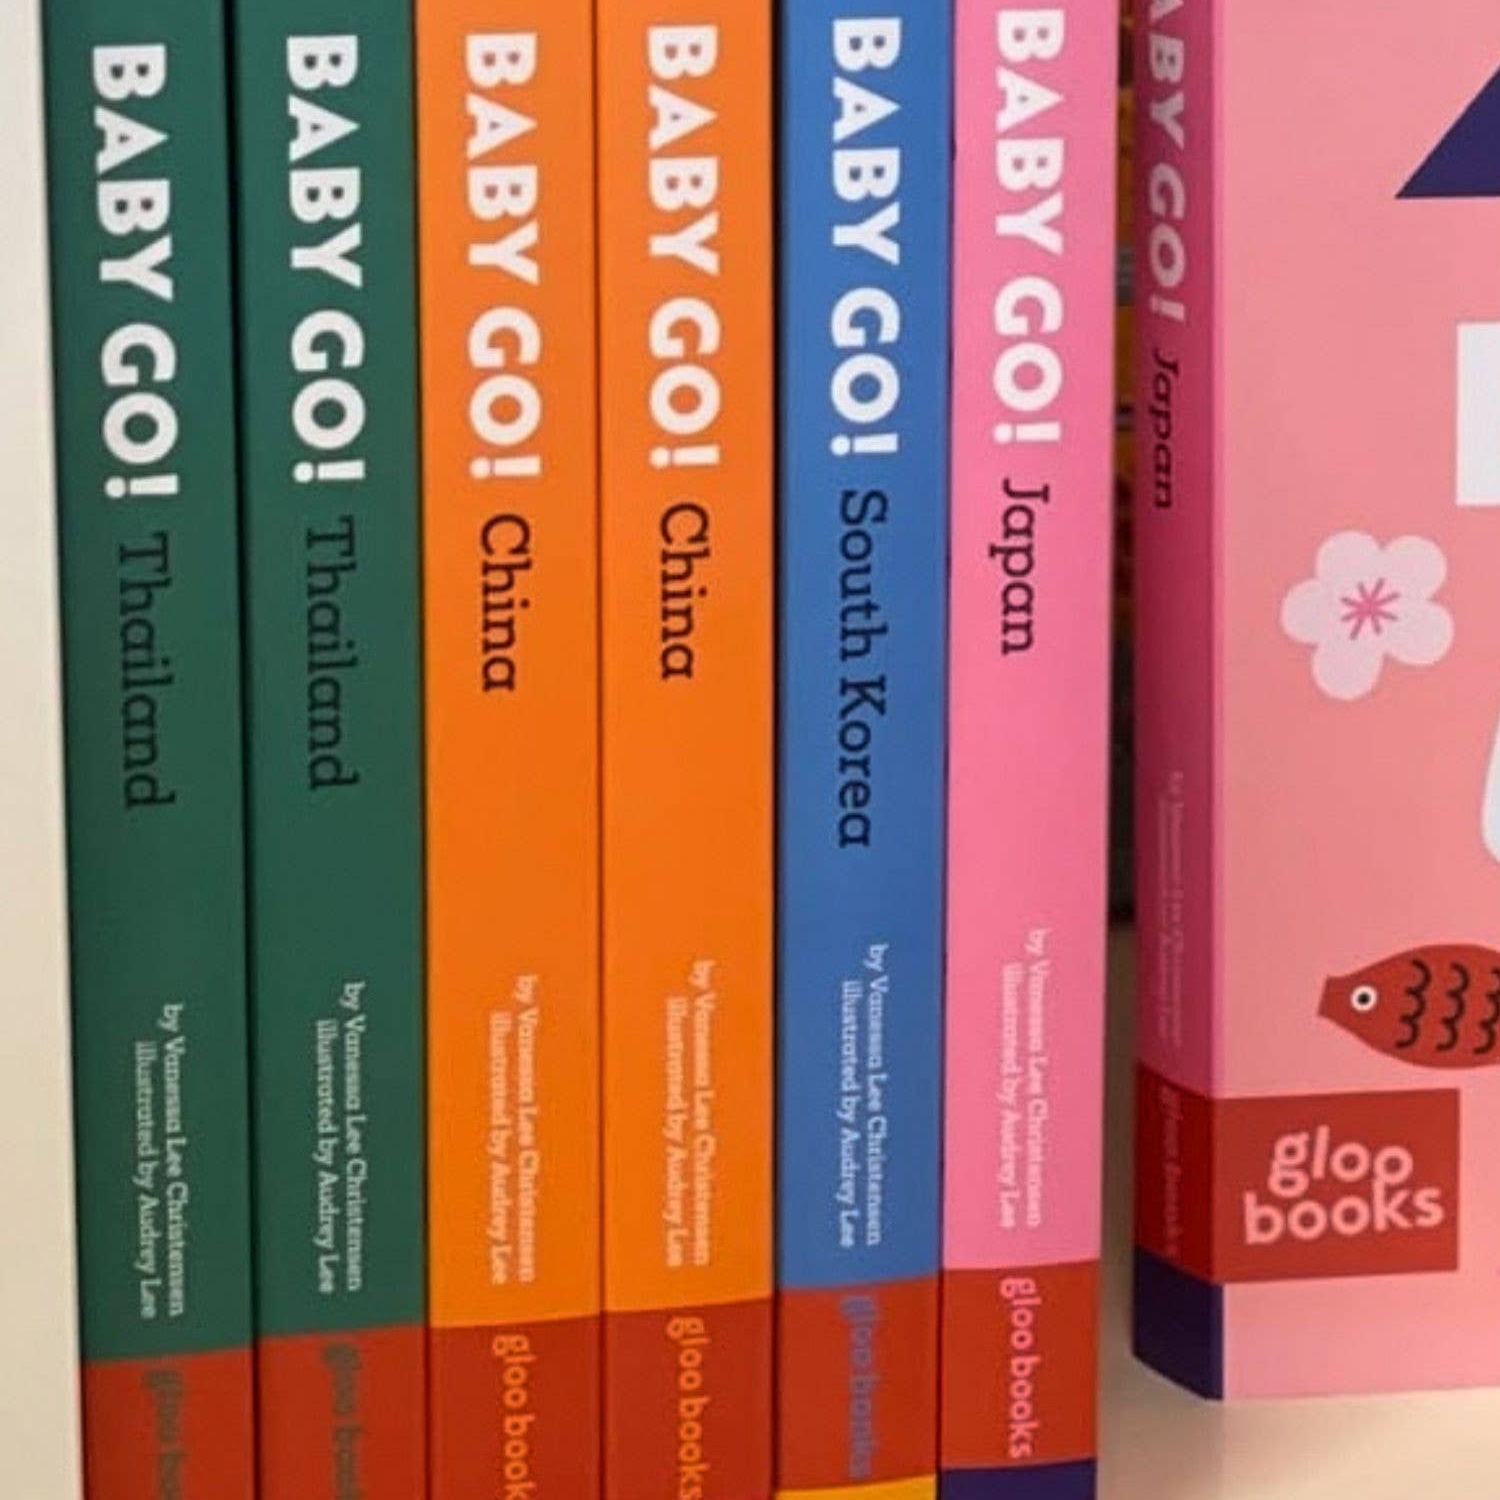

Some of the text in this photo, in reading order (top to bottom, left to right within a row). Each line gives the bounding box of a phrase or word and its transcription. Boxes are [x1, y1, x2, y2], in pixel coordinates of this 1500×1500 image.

[465, 32, 542, 693] BABY GO! China
[648, 24, 722, 681] BABY GO! China
[990, 8, 1066, 655] BABY GO! Japan
[1148, 162, 1187, 324] GO!
[92, 44, 180, 811] BABY GO! Thailand
[286, 34, 366, 792] BABY GO! Thailand
[830, 16, 902, 848] BABY GO! South Korea
[1150, 348, 1180, 509] Japan
[132, 1039, 163, 1319] illustrated by Audrey Lee
[157, 1002, 189, 1317] by Vanessa Lee Christensen
[312, 1018, 341, 1293] illustrated by Audrey Lee
[338, 981, 368, 1292] by Vanessa Lee Christensen
[836, 980, 862, 1248] illustrated by Audrey Lee
[863, 943, 890, 1246] by Vanessa Lee Christensen
[1243, 1187, 1445, 1245] books
[1266, 1124, 1414, 1198] gloo
[491, 1334, 538, 1500] gloo book
[666, 1316, 712, 1500] gloo books
[1001, 1277, 1043, 1459] gloo books
